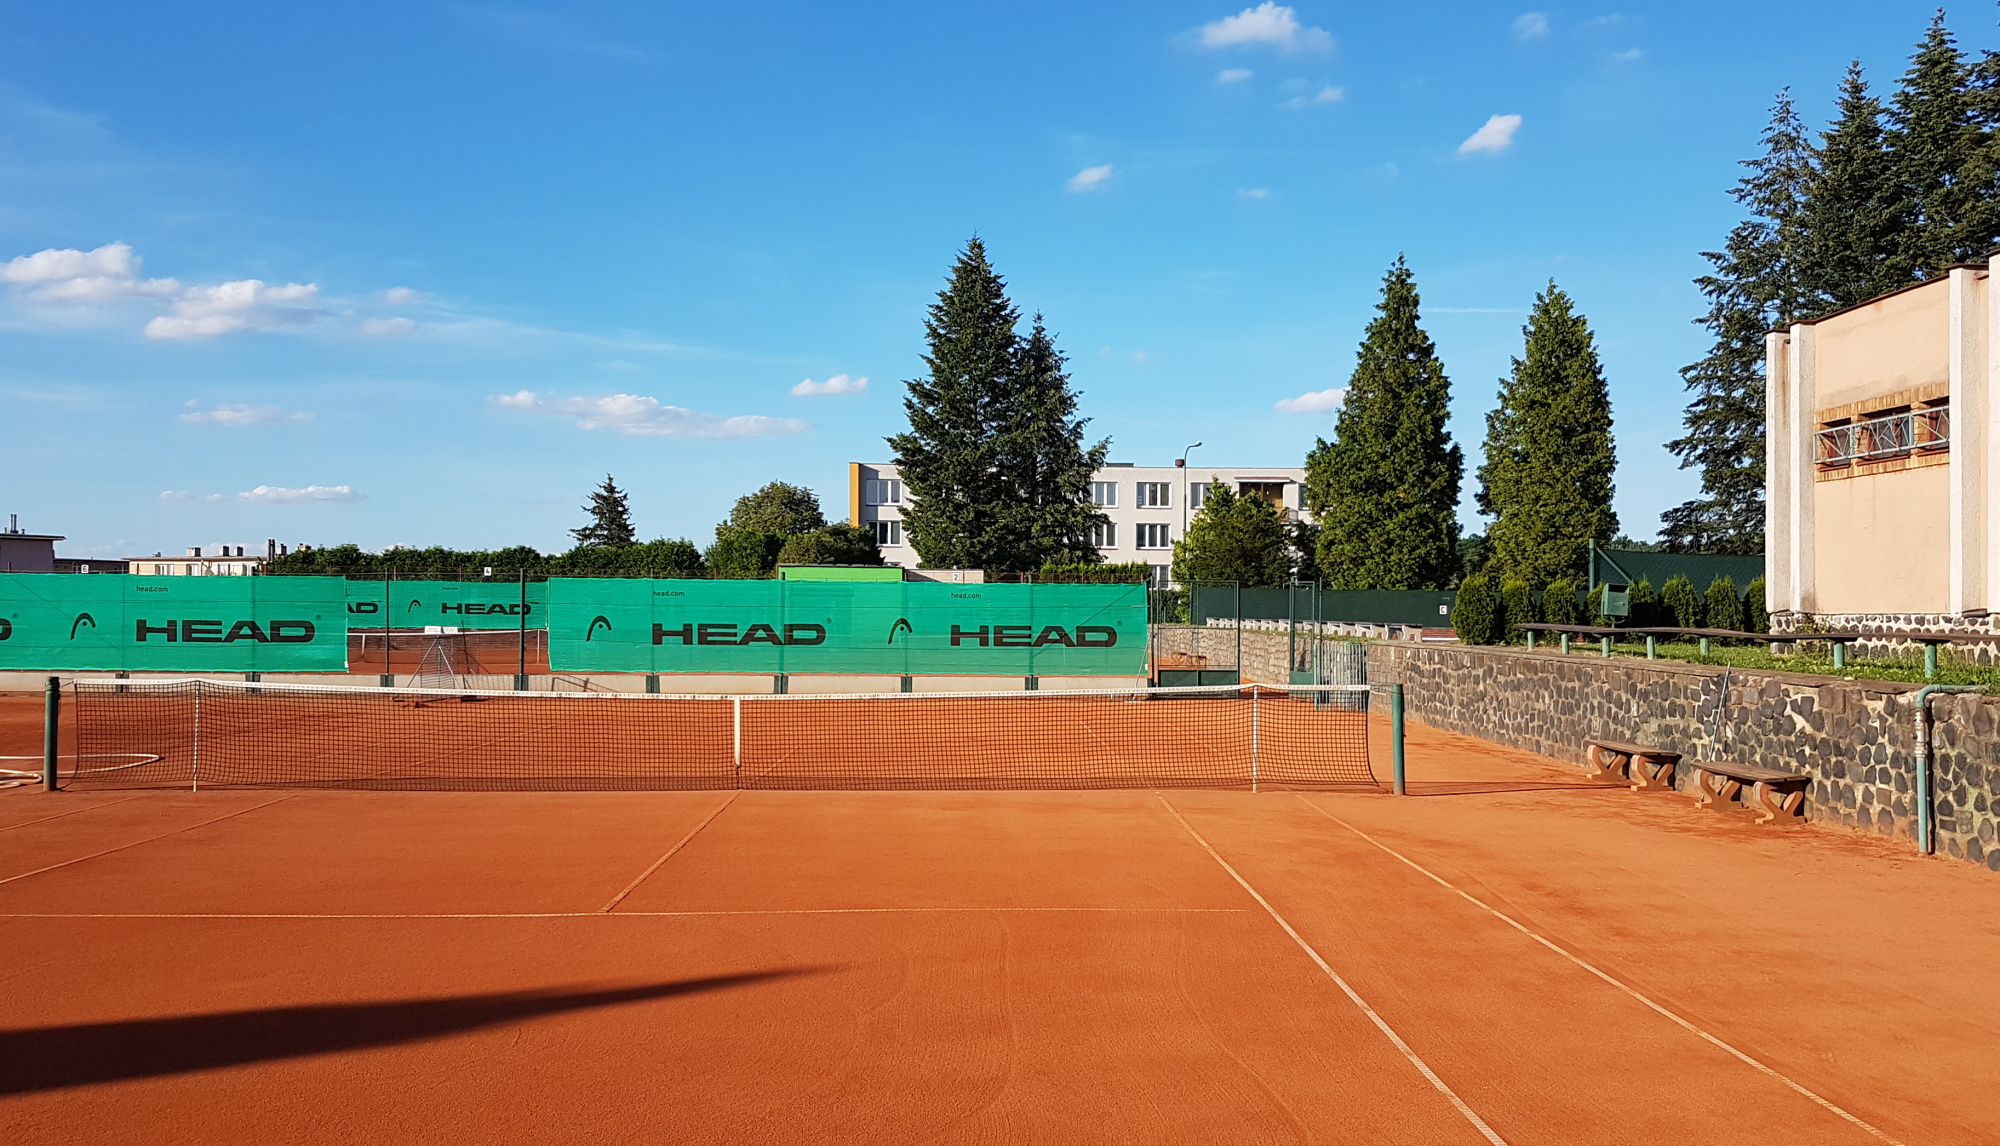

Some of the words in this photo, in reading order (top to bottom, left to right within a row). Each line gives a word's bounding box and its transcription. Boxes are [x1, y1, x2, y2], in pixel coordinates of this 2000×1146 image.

[136, 585, 169, 593] head.com
[441, 602, 532, 615] HEAD
[136, 619, 315, 643] HEAD
[652, 623, 827, 646] HEAD
[950, 624, 1118, 647] HEAD
